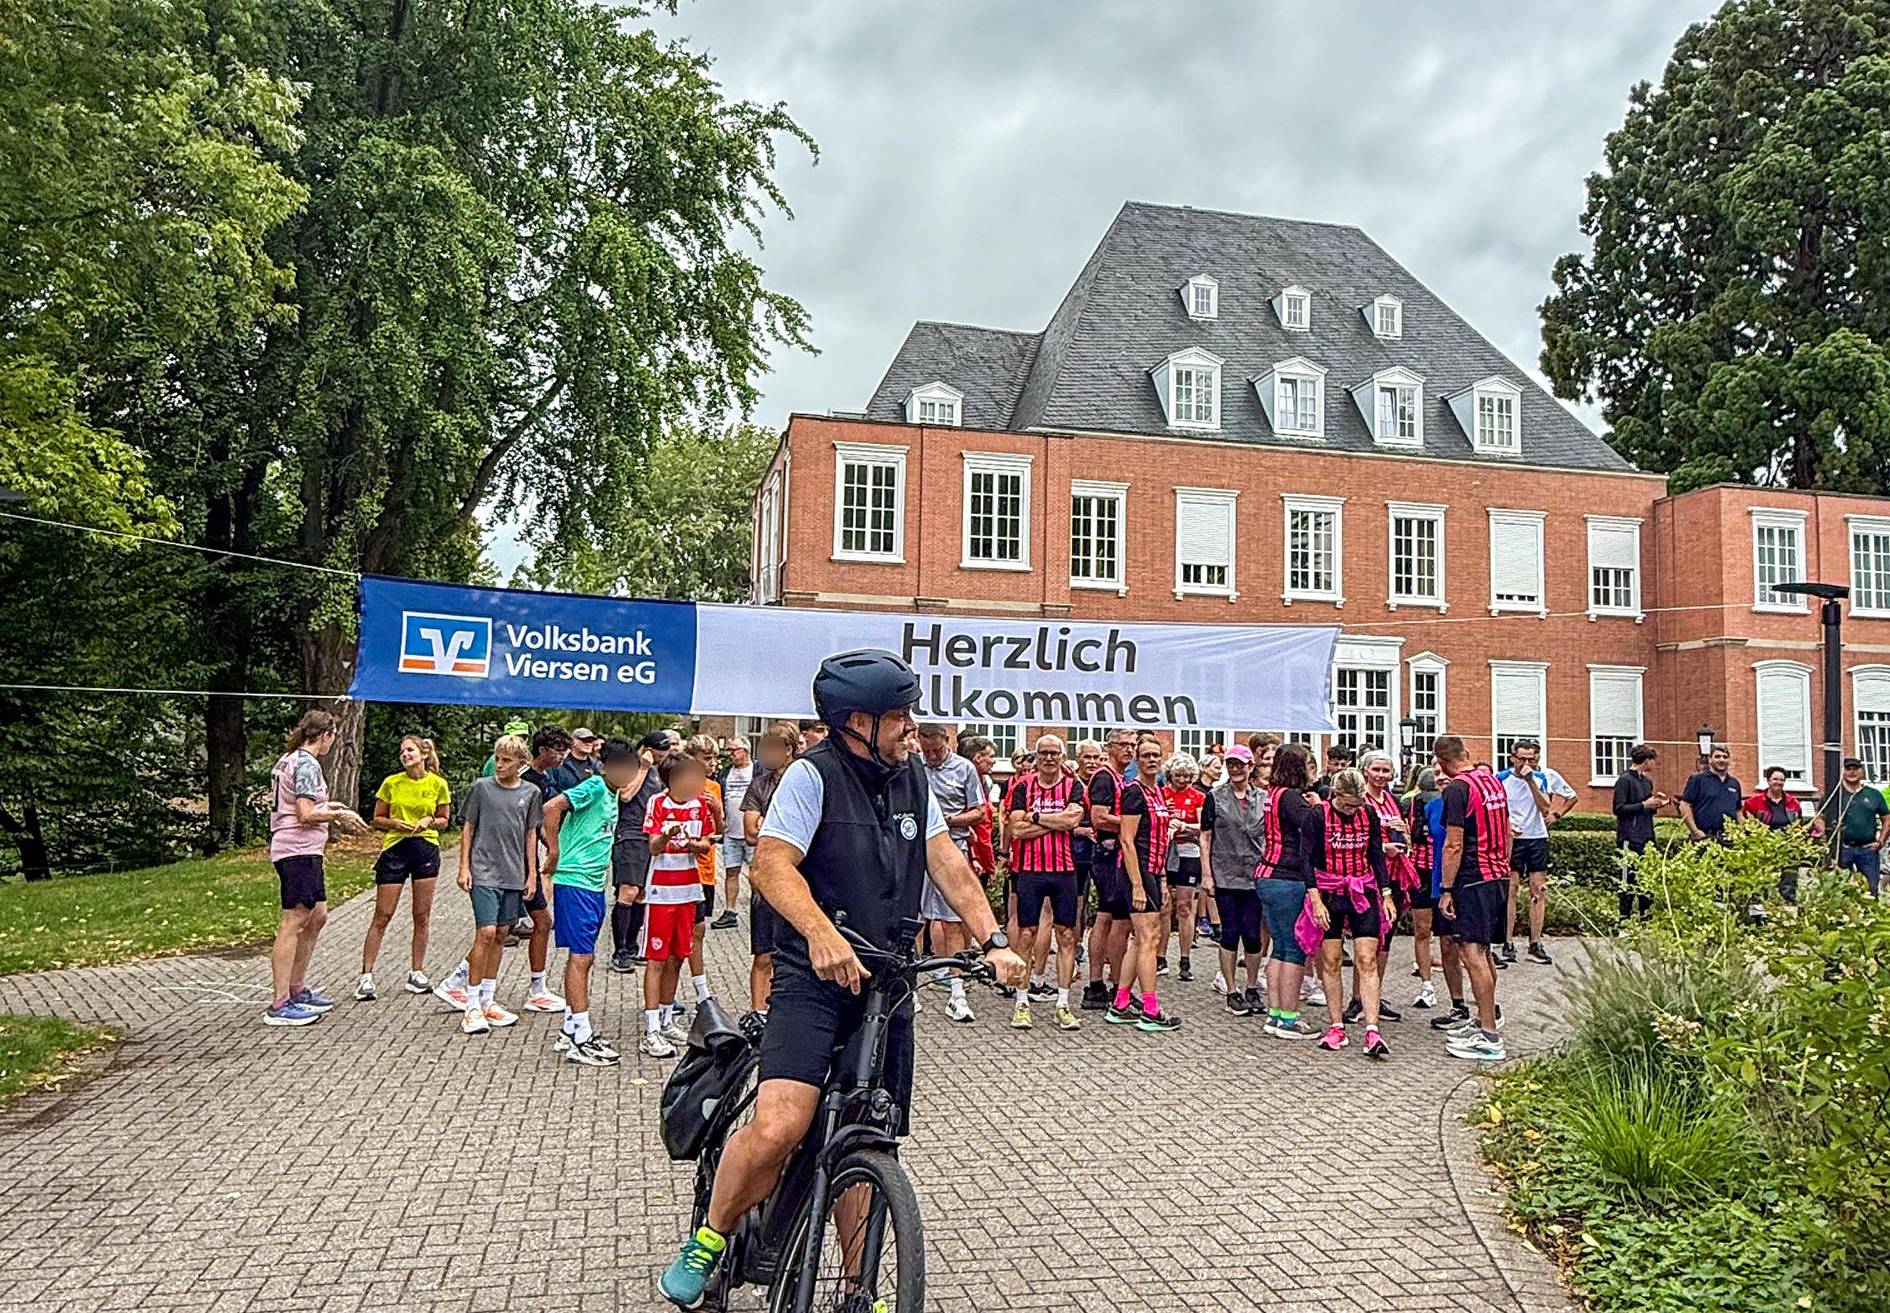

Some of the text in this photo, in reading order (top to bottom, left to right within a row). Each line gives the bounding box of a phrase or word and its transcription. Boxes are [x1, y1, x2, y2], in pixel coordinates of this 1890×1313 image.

[506, 624, 652, 656] Volksbank
[902, 622, 1136, 673] Herzlich
[504, 652, 656, 684] Viersen eG
[911, 673, 1198, 725] llkommen
